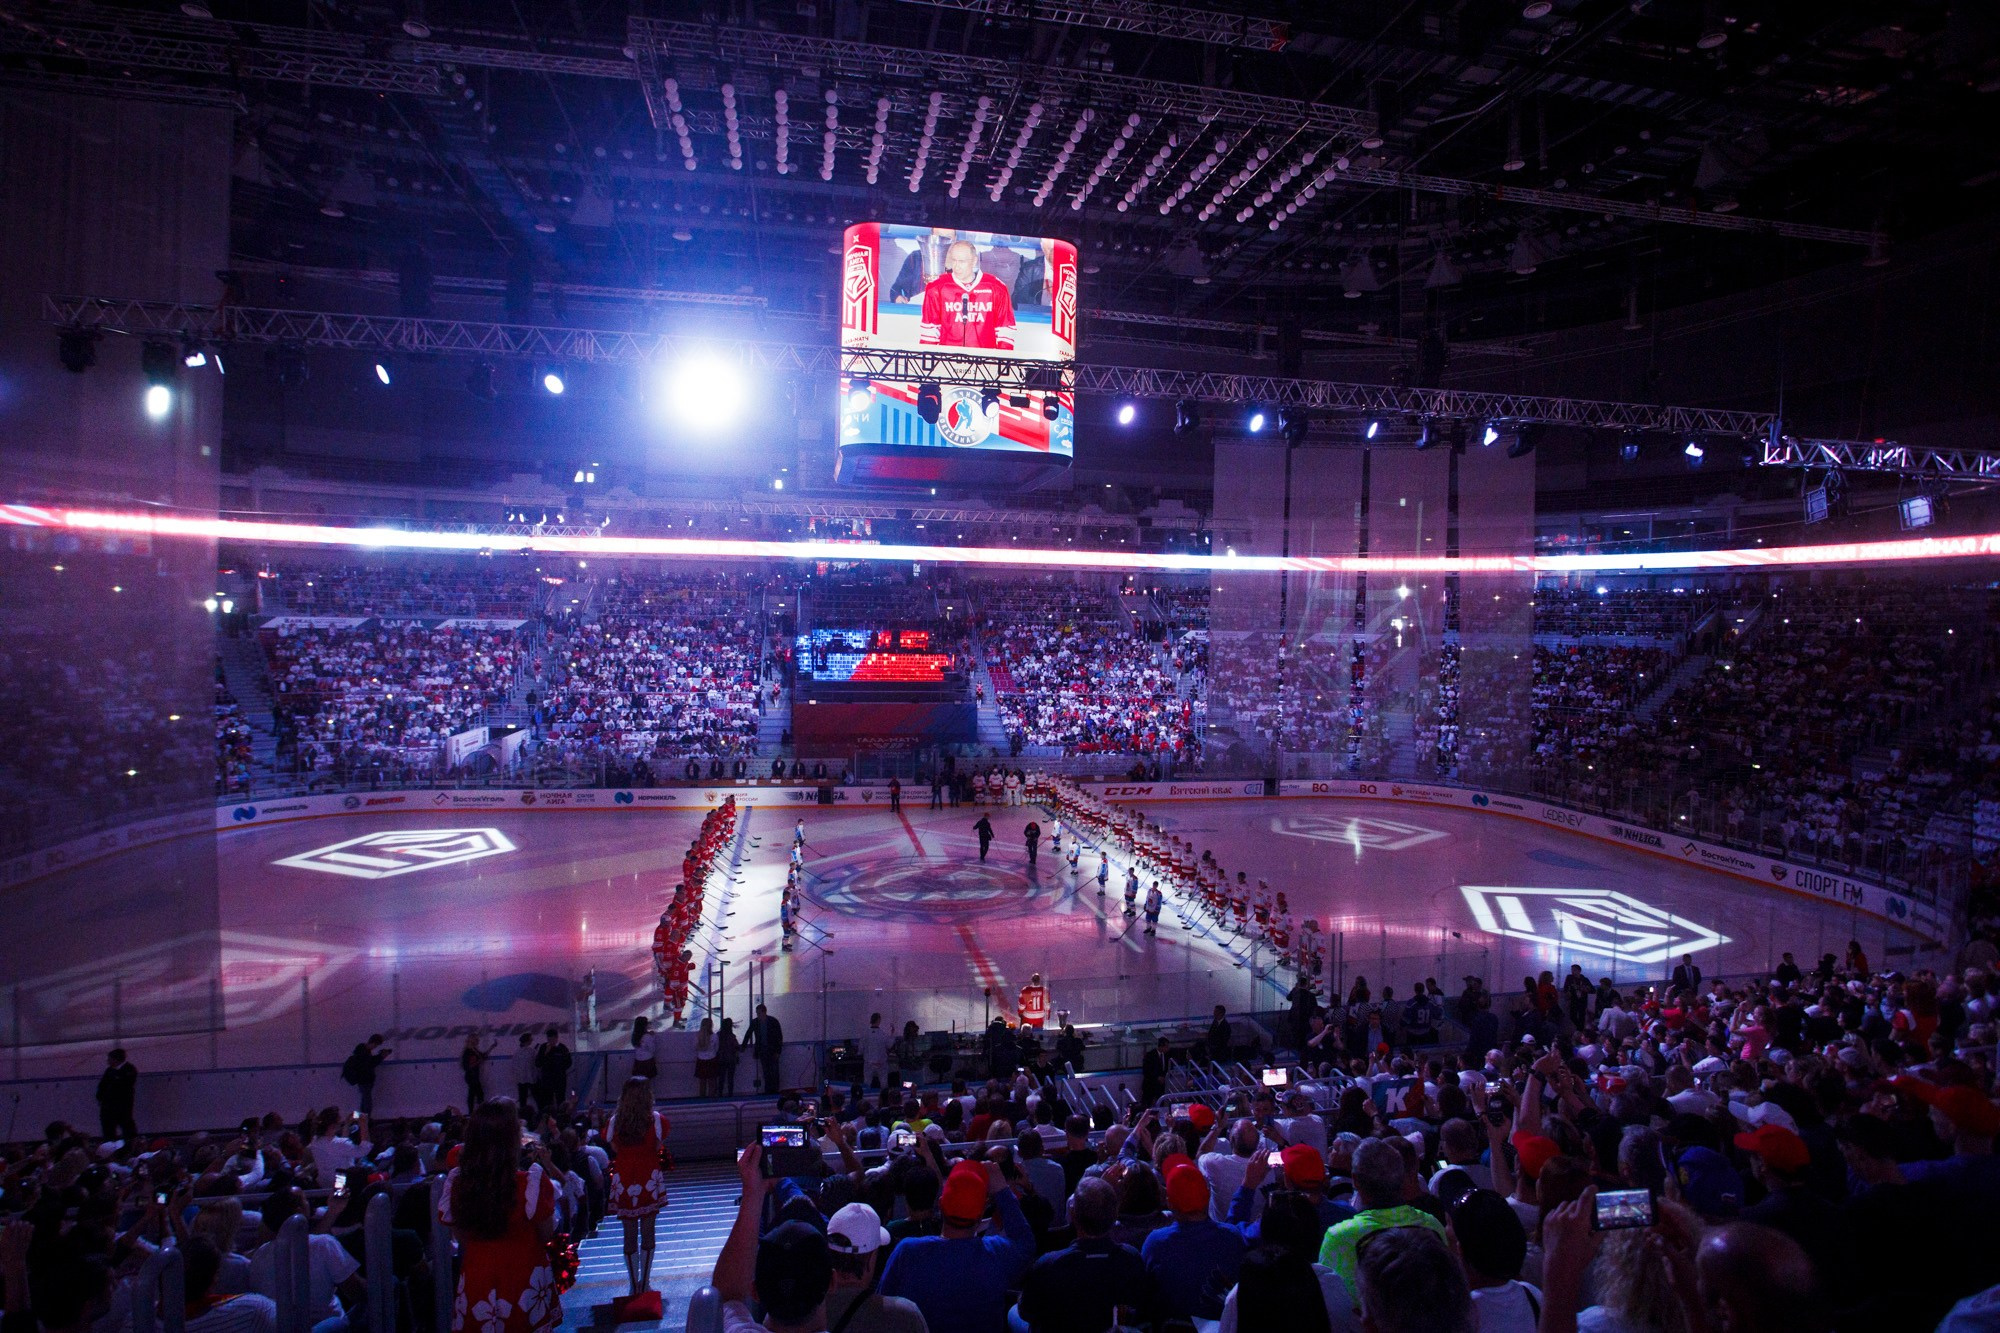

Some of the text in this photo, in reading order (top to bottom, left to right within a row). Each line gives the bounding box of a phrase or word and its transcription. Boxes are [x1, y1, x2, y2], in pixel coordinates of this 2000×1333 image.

[945, 301, 993, 312] НОНАЯ
[1104, 787, 1154, 796] CCM
[1170, 785, 1233, 796] Вятский квас
[1312, 783, 1329, 793] BQ
[1360, 784, 1378, 794] BQ
[1542, 807, 1583, 827] LEDENEV
[1701, 849, 1756, 870] ВостокУголь
[1795, 870, 1863, 904] СПОРТ FM
[1032, 996, 1041, 1010] 11
[1417, 1008, 1430, 1024] 91
